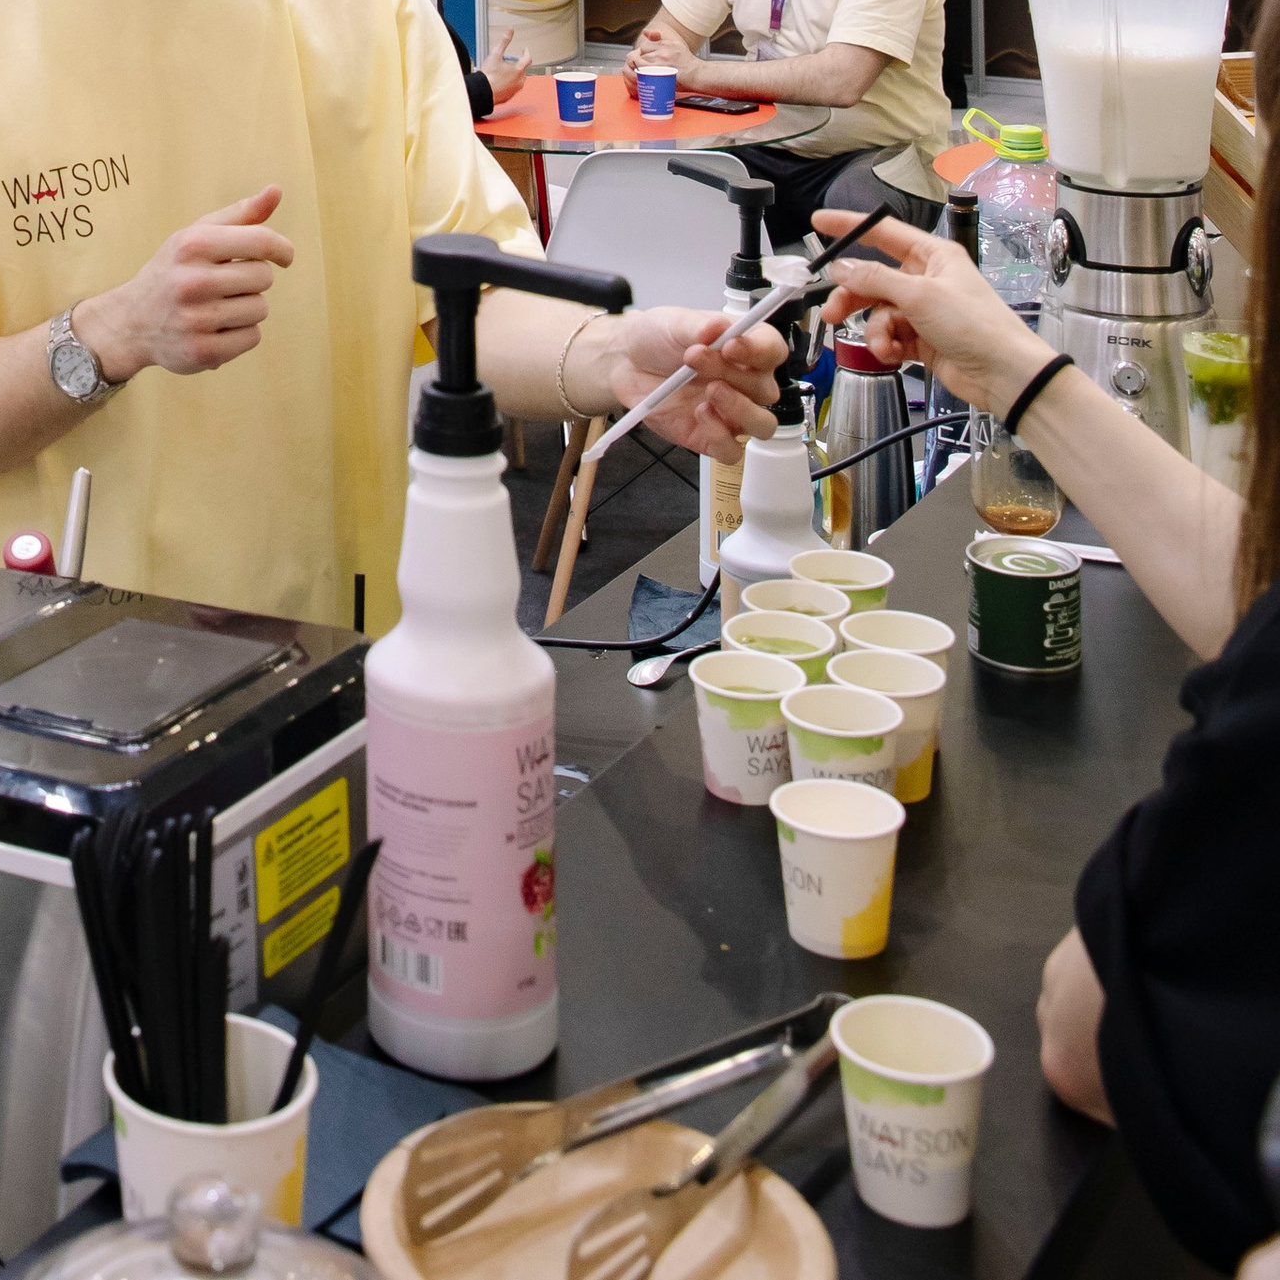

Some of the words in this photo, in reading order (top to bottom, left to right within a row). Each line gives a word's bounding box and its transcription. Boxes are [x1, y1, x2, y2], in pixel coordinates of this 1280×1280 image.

[1, 154, 130, 209] WATSON
[13, 204, 94, 247] SAYS
[1107, 335, 1153, 349] BORK
[854, 1109, 969, 1156] WATSON
